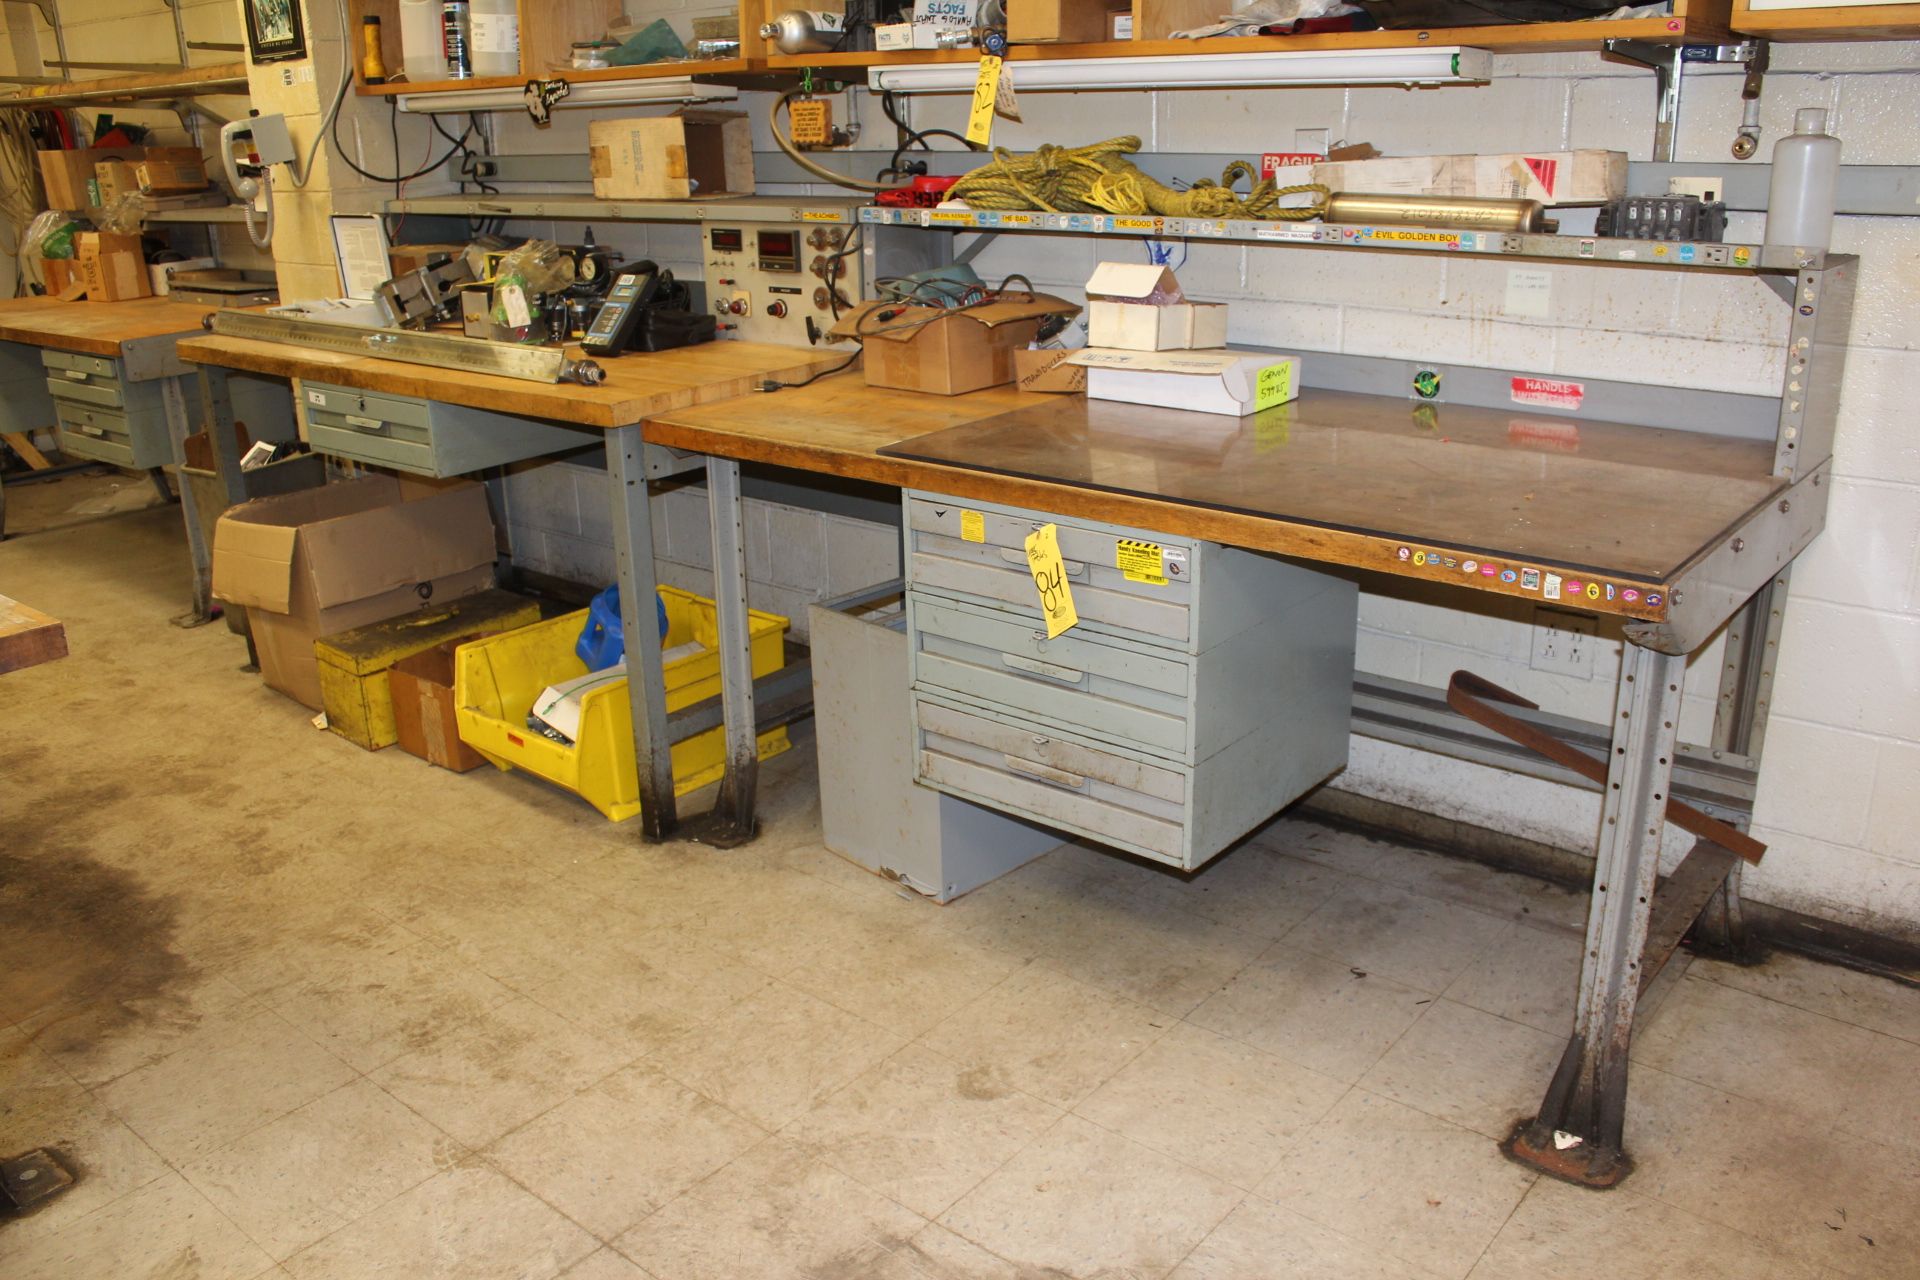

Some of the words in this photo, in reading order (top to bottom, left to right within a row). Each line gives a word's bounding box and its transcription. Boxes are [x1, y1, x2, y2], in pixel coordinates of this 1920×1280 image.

[928, 2, 965, 15] FACTS
[1115, 219, 1129, 227] THE
[1131, 220, 1152, 228] GOOD
[1375, 230, 1395, 239] EVIL
[1398, 231, 1436, 242] GOLDEN
[1439, 233, 1458, 242] BOY
[1526, 379, 1572, 394] HANDLE
[1035, 561, 1065, 612] 84
